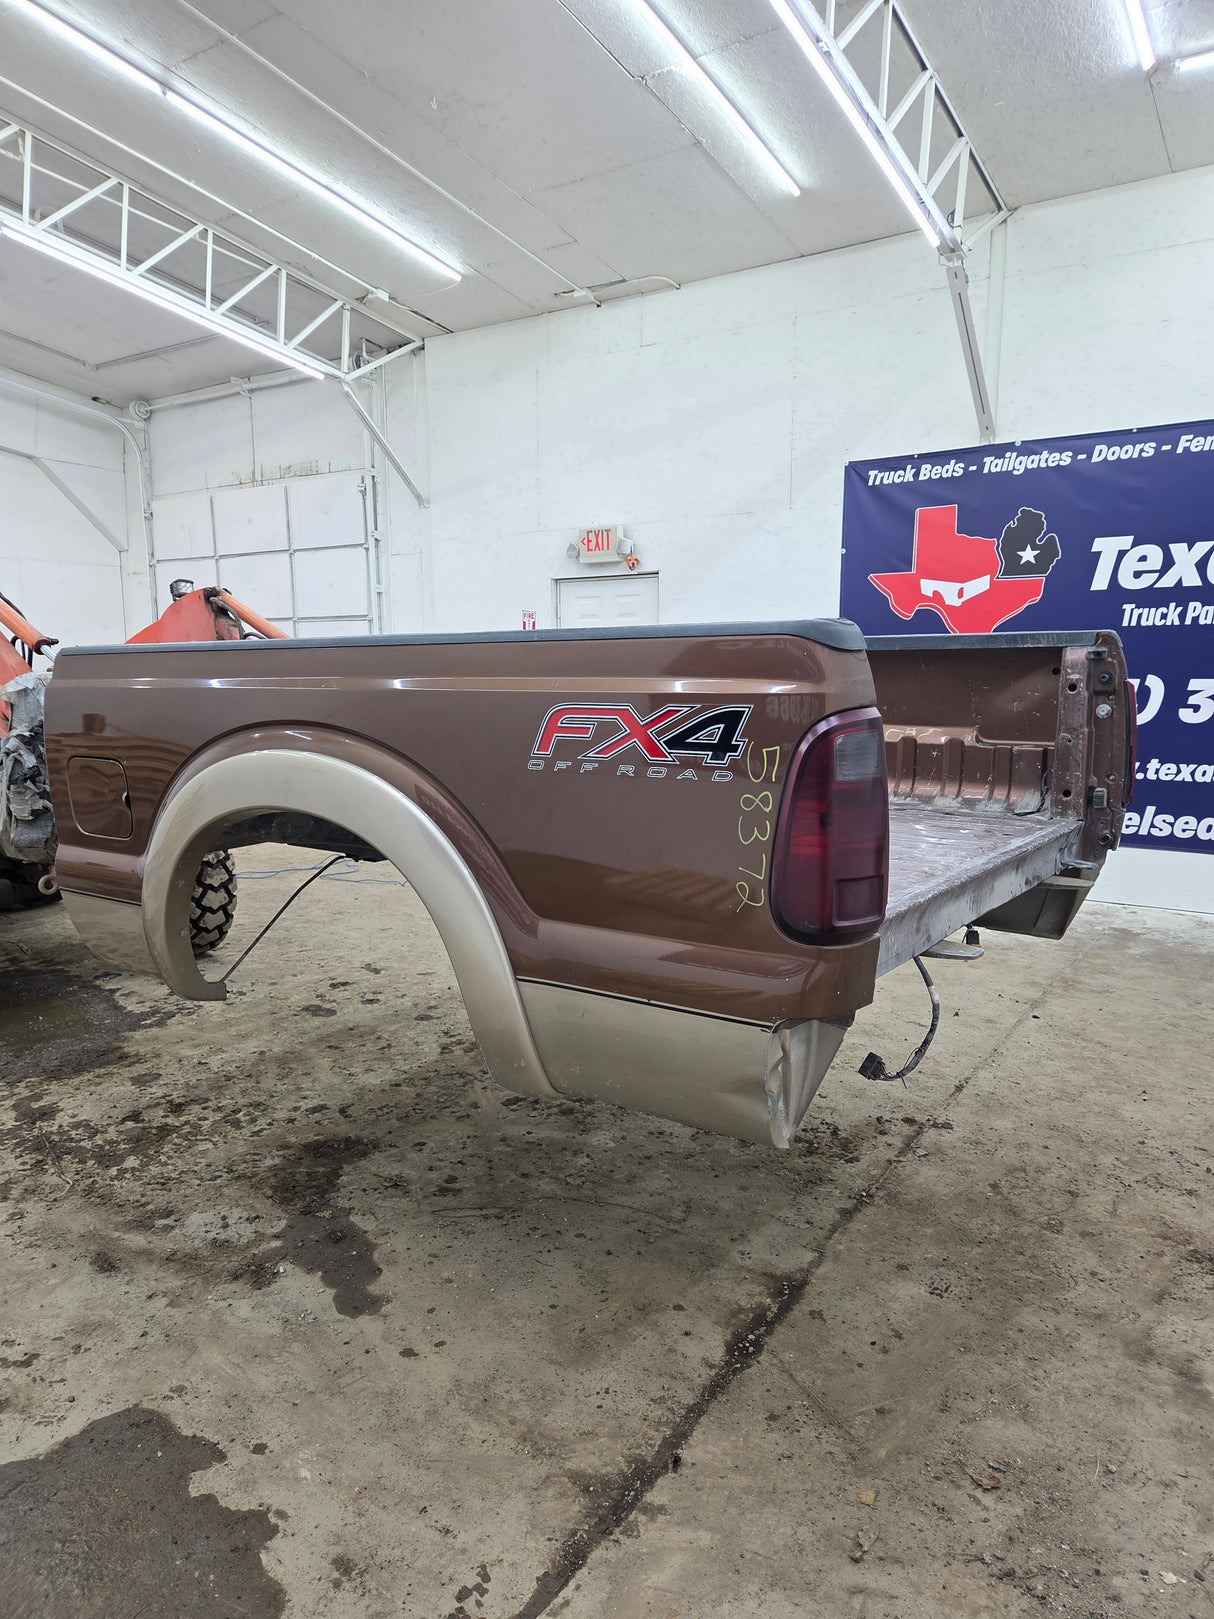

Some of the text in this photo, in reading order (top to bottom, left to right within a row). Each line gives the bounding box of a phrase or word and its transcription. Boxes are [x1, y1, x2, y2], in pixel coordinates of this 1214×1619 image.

[867, 465, 915, 486] Truck
[919, 459, 965, 481] Beds
[982, 449, 1073, 475] Tailgates
[1091, 442, 1157, 463] Doors
[586, 528, 612, 552] EXIT
[1090, 535, 1214, 591] Tex
[523, 612, 535, 620] FIRE
[1121, 601, 1214, 627] Truck Pa
[531, 702, 754, 767] FX4
[527, 759, 734, 782] OFF ROAD
[1134, 758, 1214, 783] .texa
